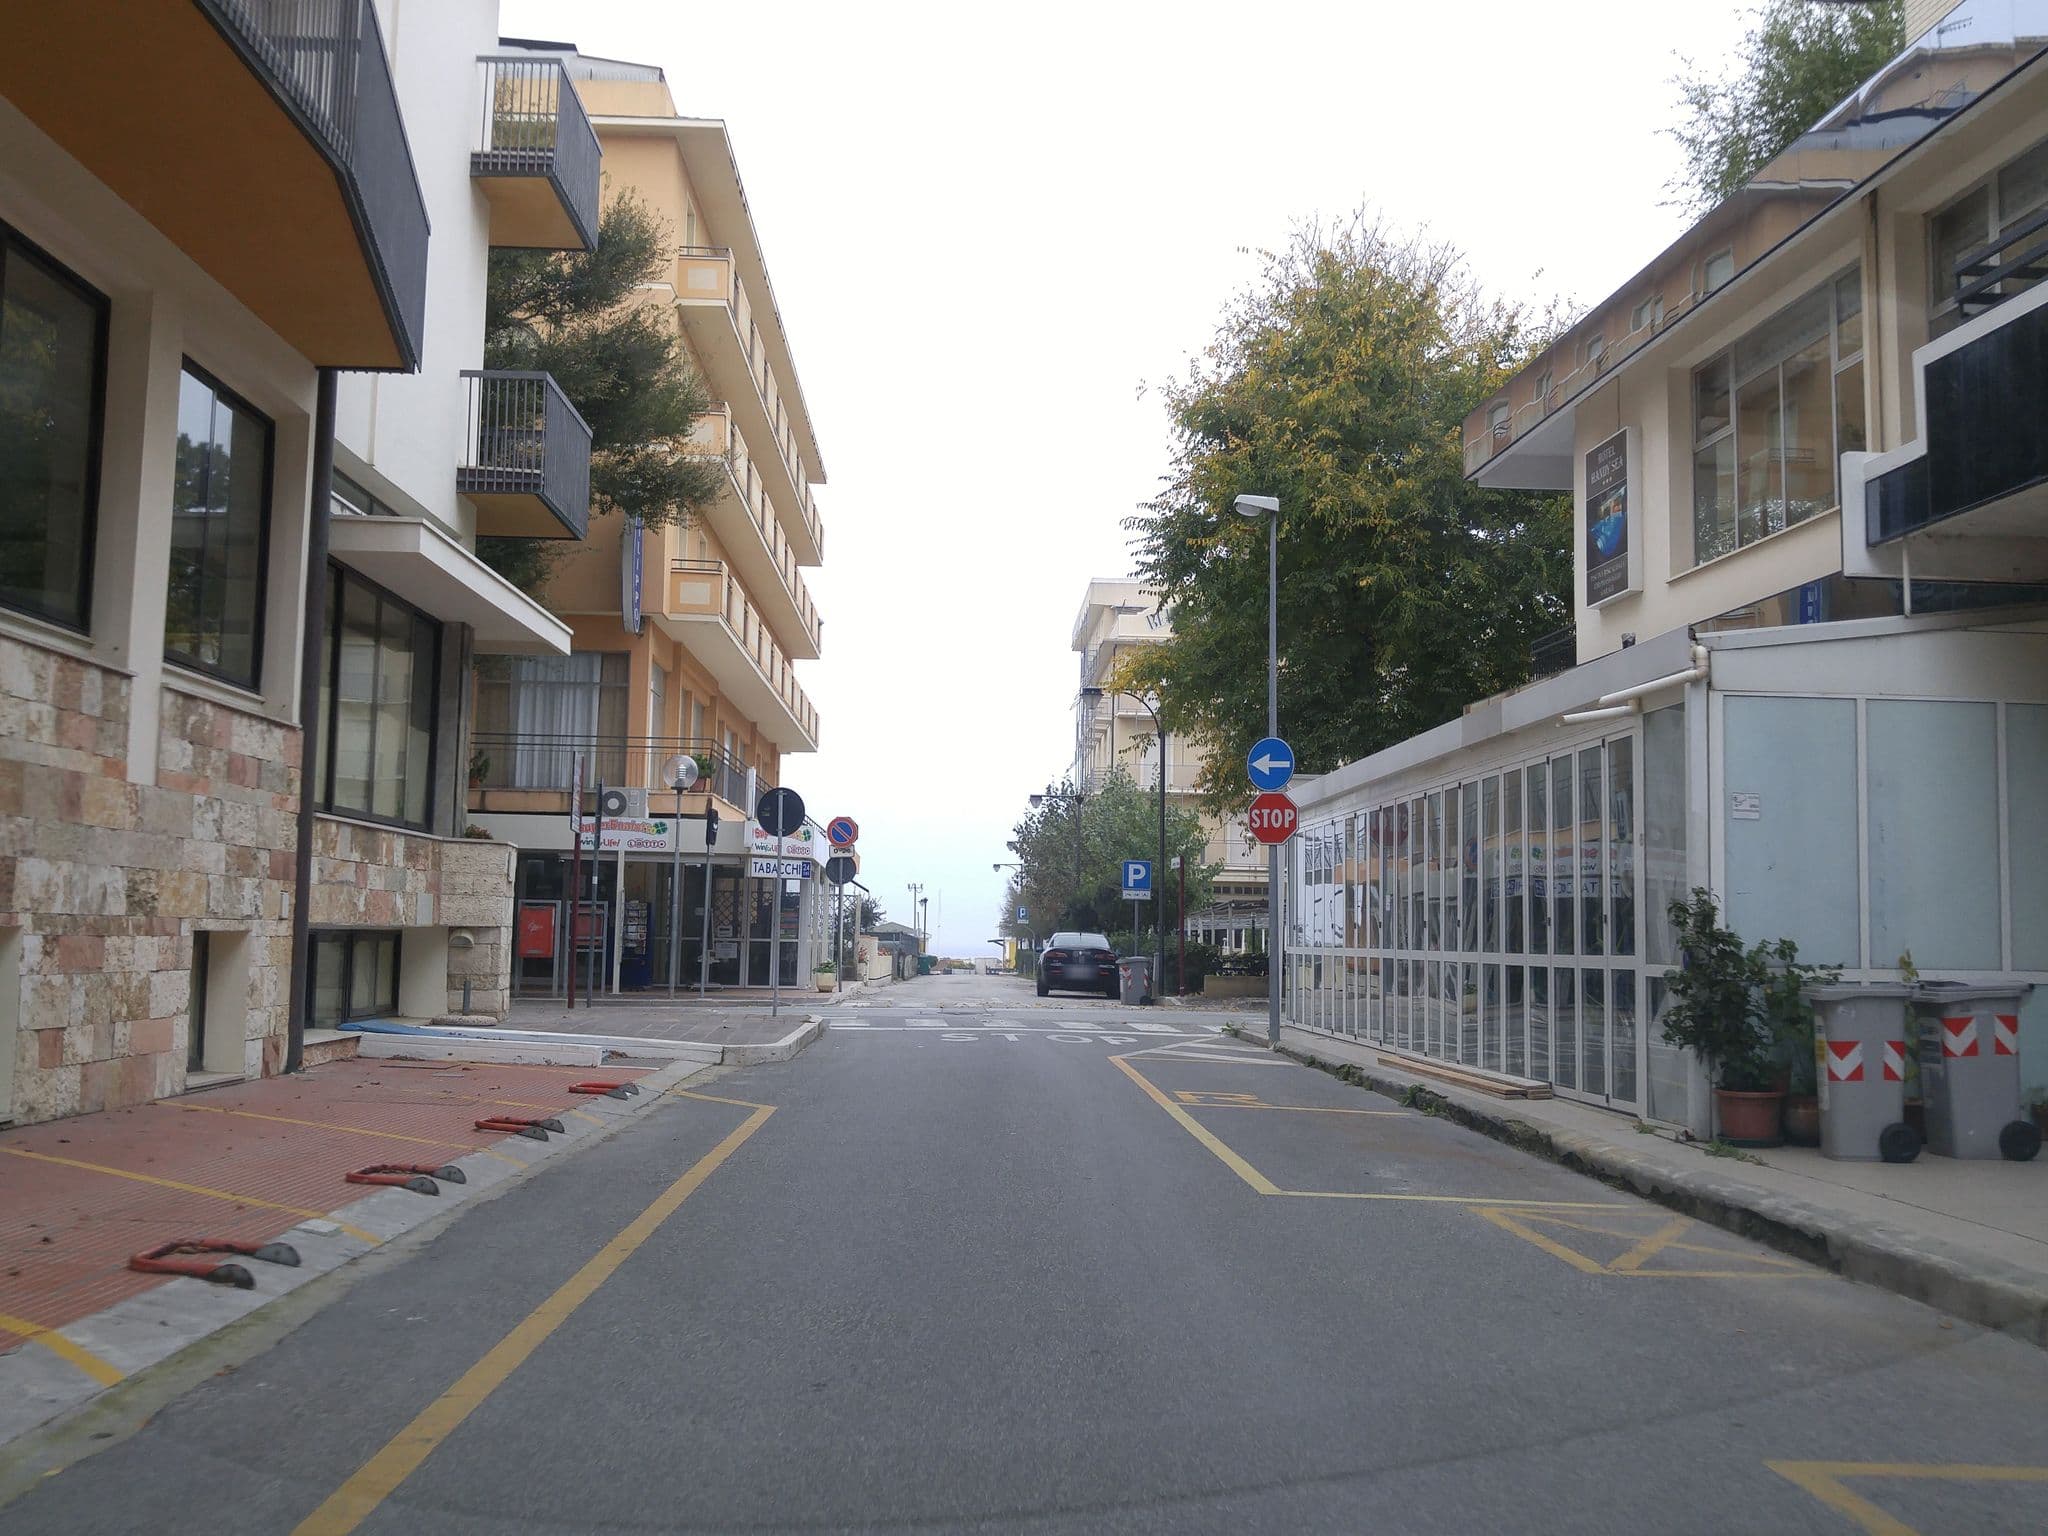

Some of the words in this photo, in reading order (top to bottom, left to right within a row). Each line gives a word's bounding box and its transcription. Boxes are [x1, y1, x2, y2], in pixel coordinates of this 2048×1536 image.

[1251, 808, 1295, 829] STOP
[1128, 863, 1146, 887] P
[940, 1032, 1138, 1045] STOP
